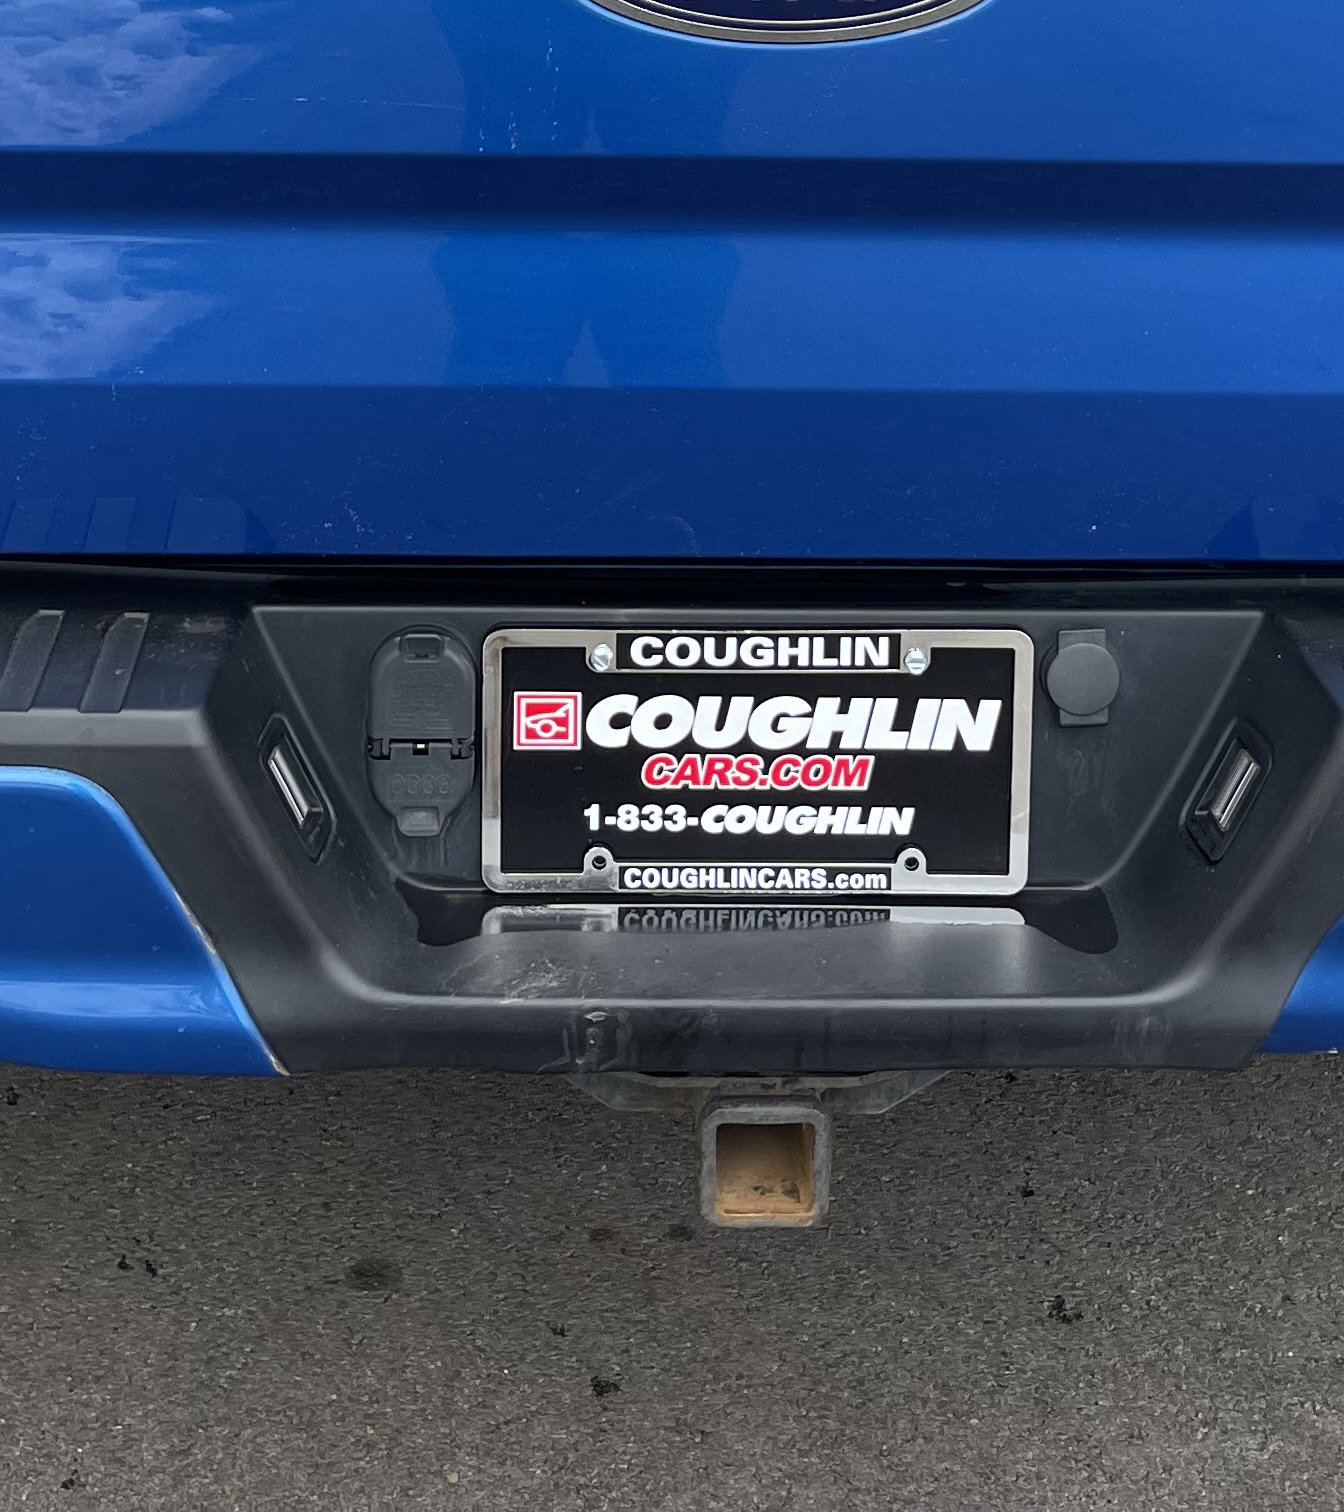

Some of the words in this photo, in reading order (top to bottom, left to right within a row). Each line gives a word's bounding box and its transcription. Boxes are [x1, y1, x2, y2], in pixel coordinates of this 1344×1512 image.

[629, 636, 891, 668] COUGHLIN
[585, 694, 1003, 752] COUGHLIN
[641, 753, 876, 791] CARS.COM
[582, 803, 916, 836] 1-833-COUGHLIN
[623, 867, 888, 890] COUGHLINCARS.com
